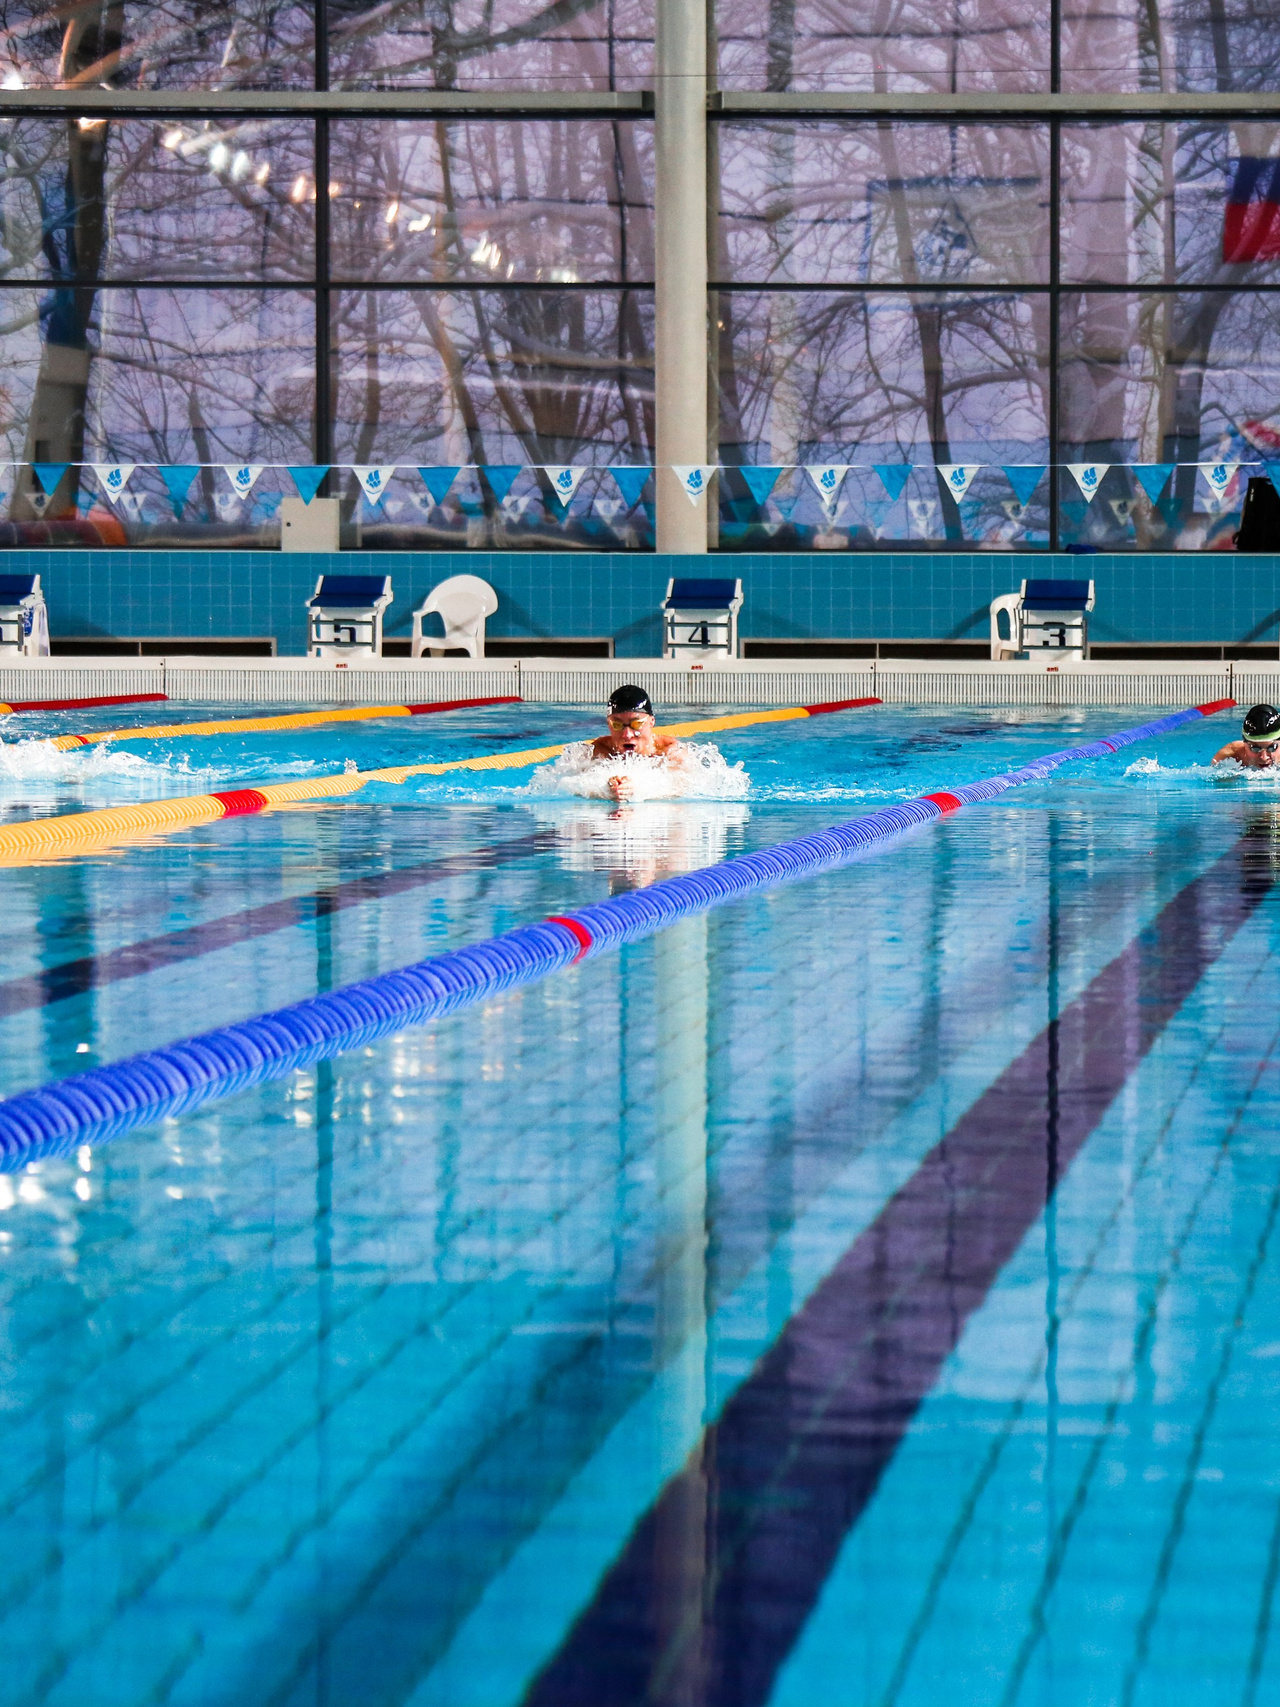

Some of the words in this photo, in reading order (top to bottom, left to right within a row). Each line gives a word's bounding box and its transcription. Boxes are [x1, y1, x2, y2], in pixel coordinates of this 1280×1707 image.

[334, 618, 356, 647] 5
[688, 620, 710, 650] 4
[1043, 621, 1066, 650] 3
